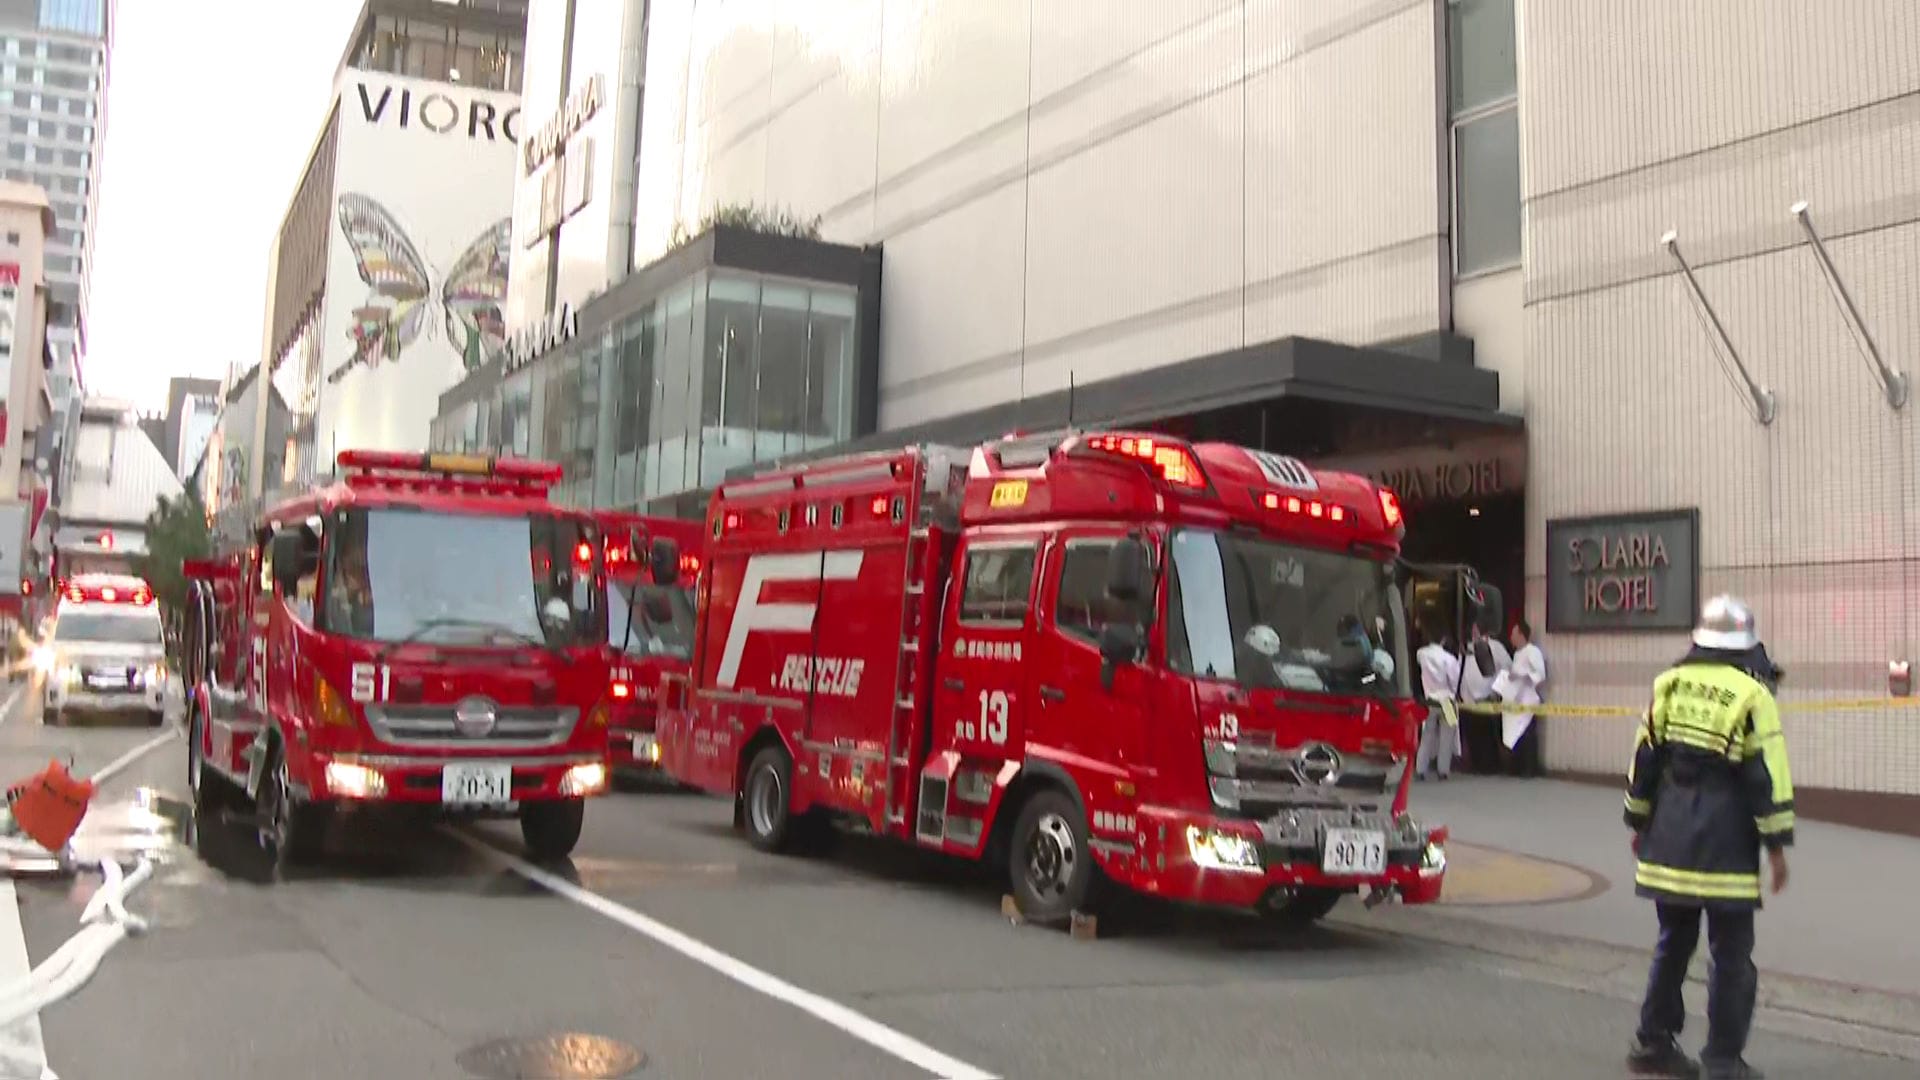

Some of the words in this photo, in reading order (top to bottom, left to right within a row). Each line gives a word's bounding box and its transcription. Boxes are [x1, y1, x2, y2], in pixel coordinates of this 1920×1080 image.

[1435, 458, 1505, 497] HOTEL
[1567, 533, 1671, 573] SOLARIA
[1584, 574, 1657, 614] HOTEL
[716, 550, 864, 688] F
[779, 653, 865, 699] RESCUE
[979, 688, 1009, 747] 13
[1219, 712, 1238, 739] 13
